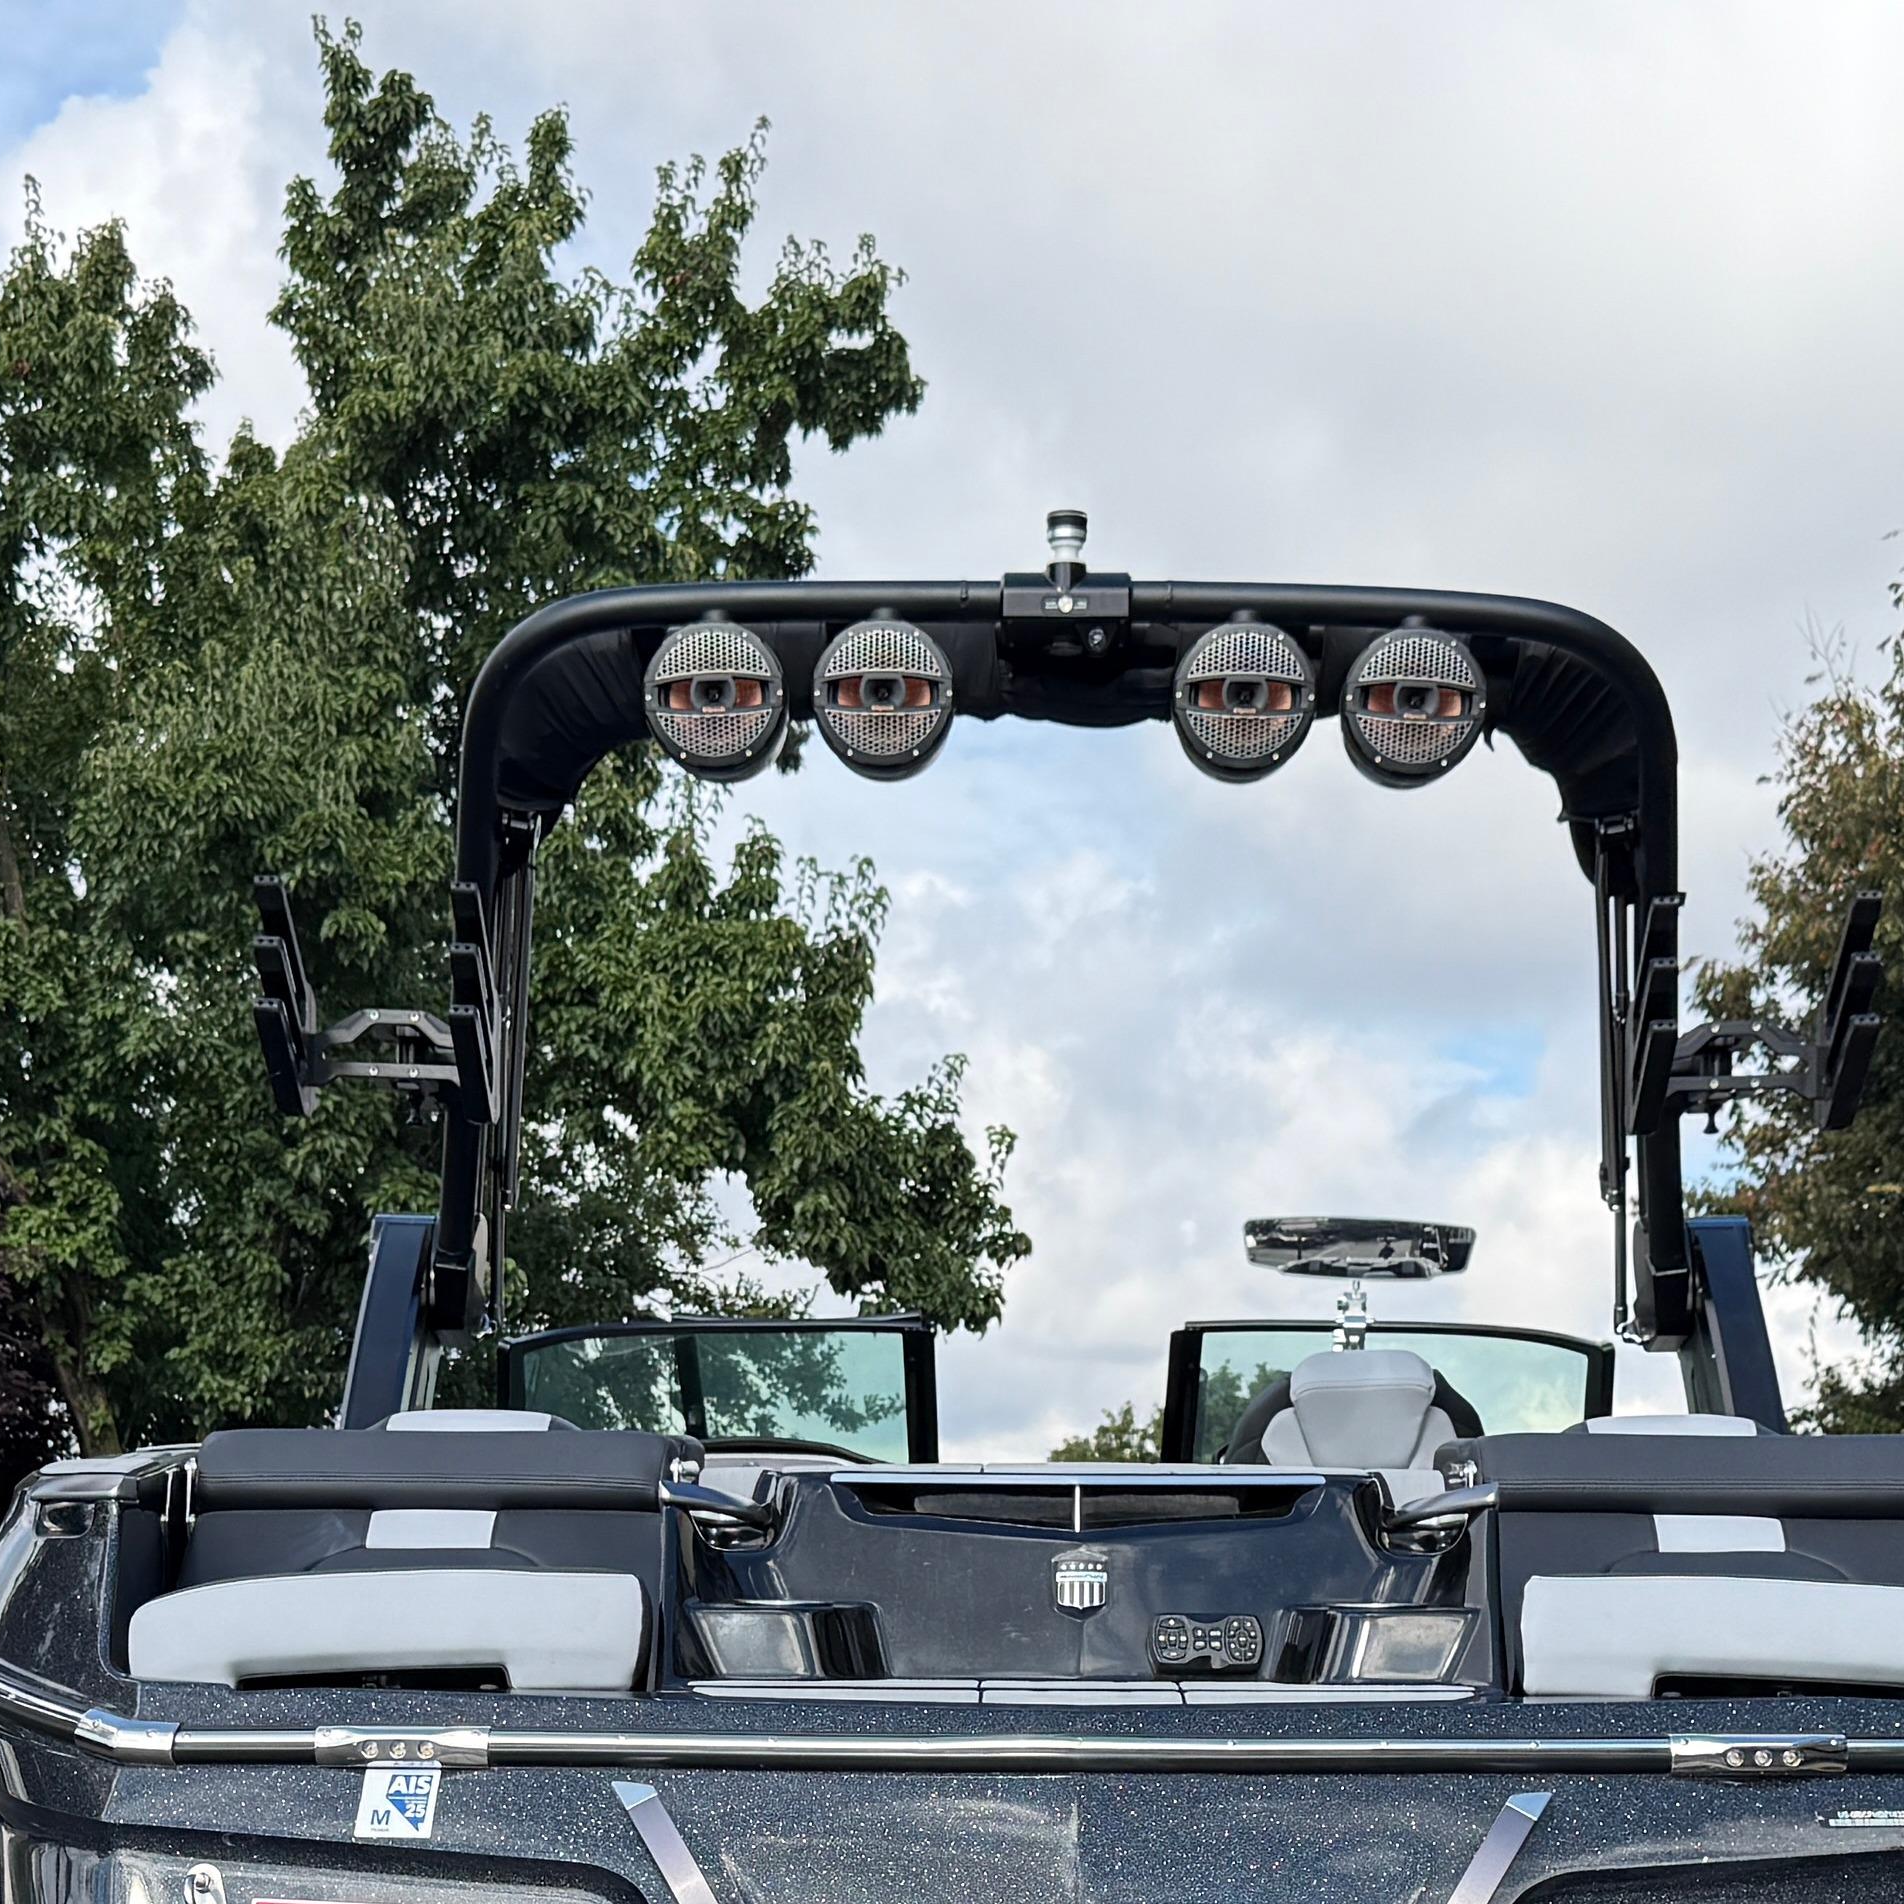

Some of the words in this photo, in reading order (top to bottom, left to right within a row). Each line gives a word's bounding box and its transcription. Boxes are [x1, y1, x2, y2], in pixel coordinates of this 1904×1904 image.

[388, 1775, 432, 1795] AIS
[370, 1809, 391, 1826] M
[404, 1803, 426, 1818] 25
